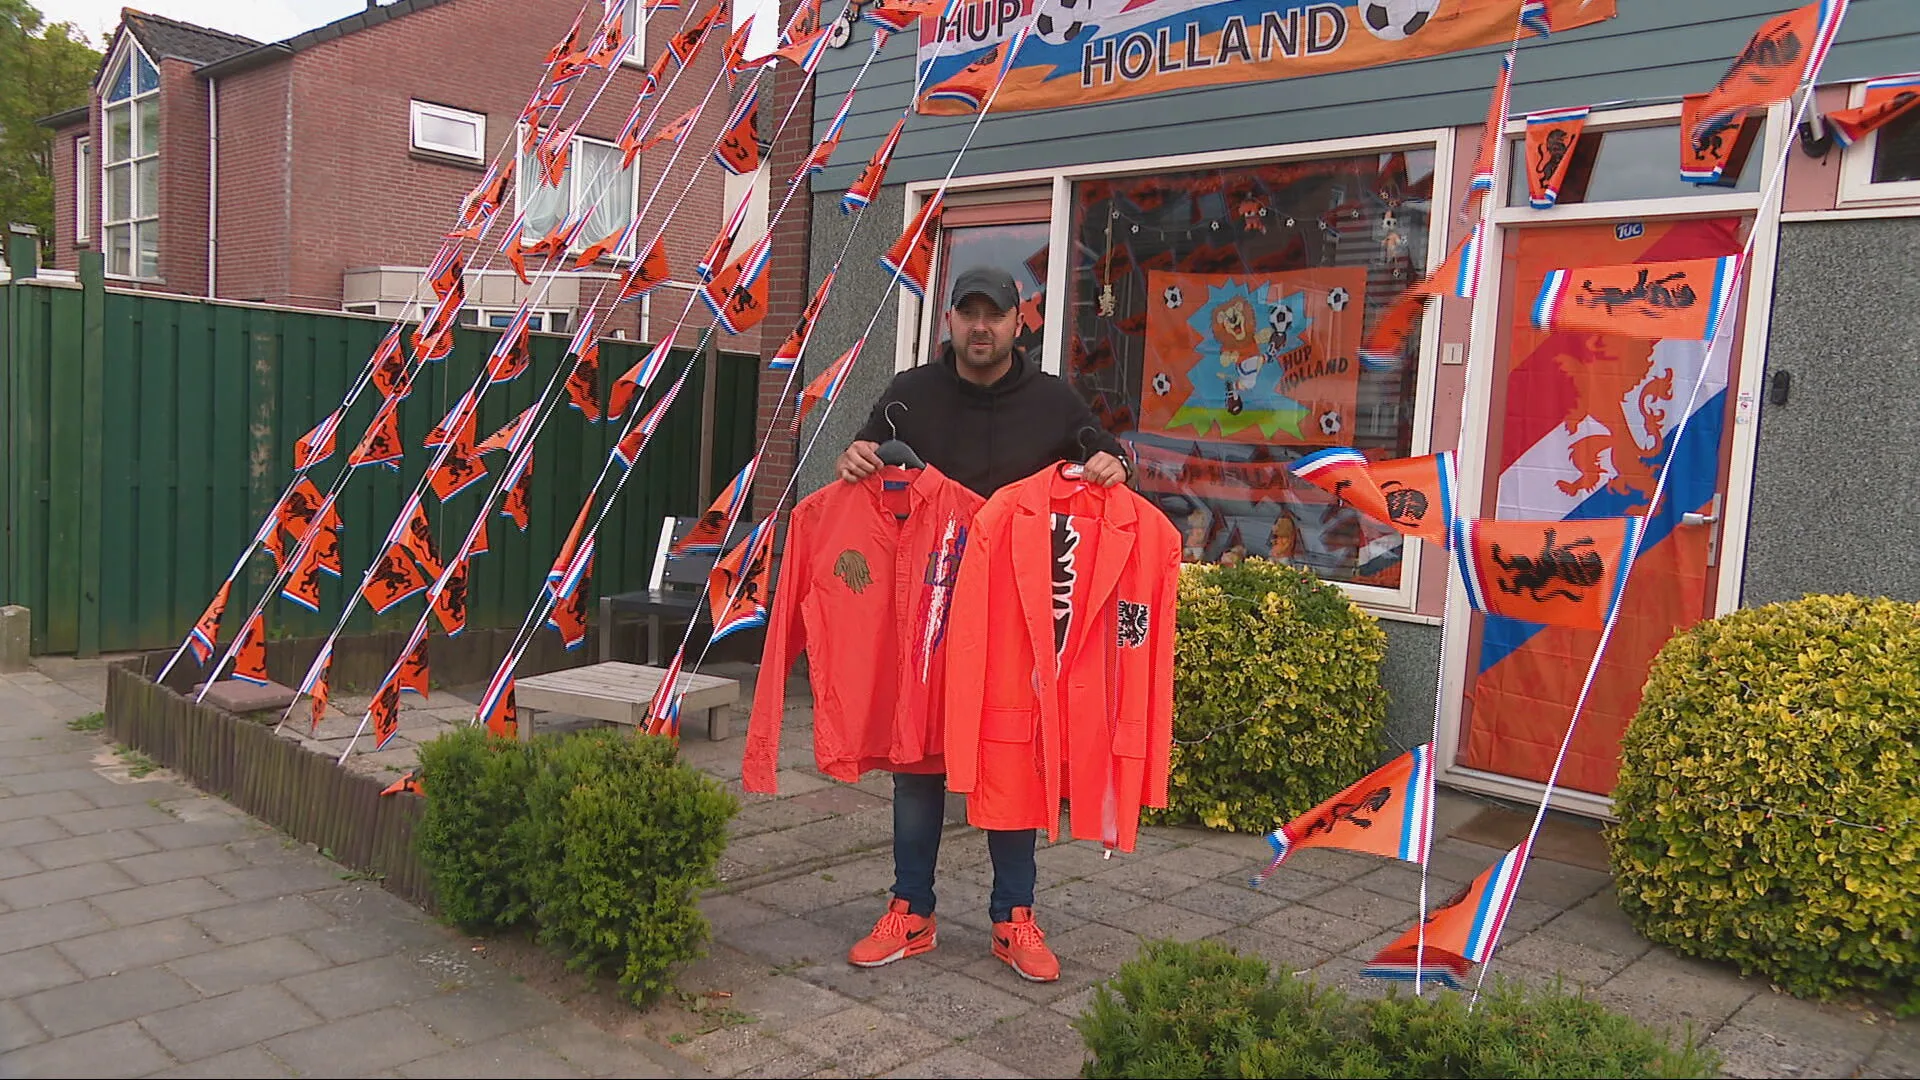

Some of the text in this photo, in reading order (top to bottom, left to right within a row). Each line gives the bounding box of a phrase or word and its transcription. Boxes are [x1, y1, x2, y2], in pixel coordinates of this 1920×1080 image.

[936, 0, 1021, 43] HUP
[1082, 4, 1348, 87] HOLLAND
[1617, 223, 1642, 238] TUC
[1280, 357, 1349, 393] HOLLAND
[1282, 345, 1312, 371] HUP
